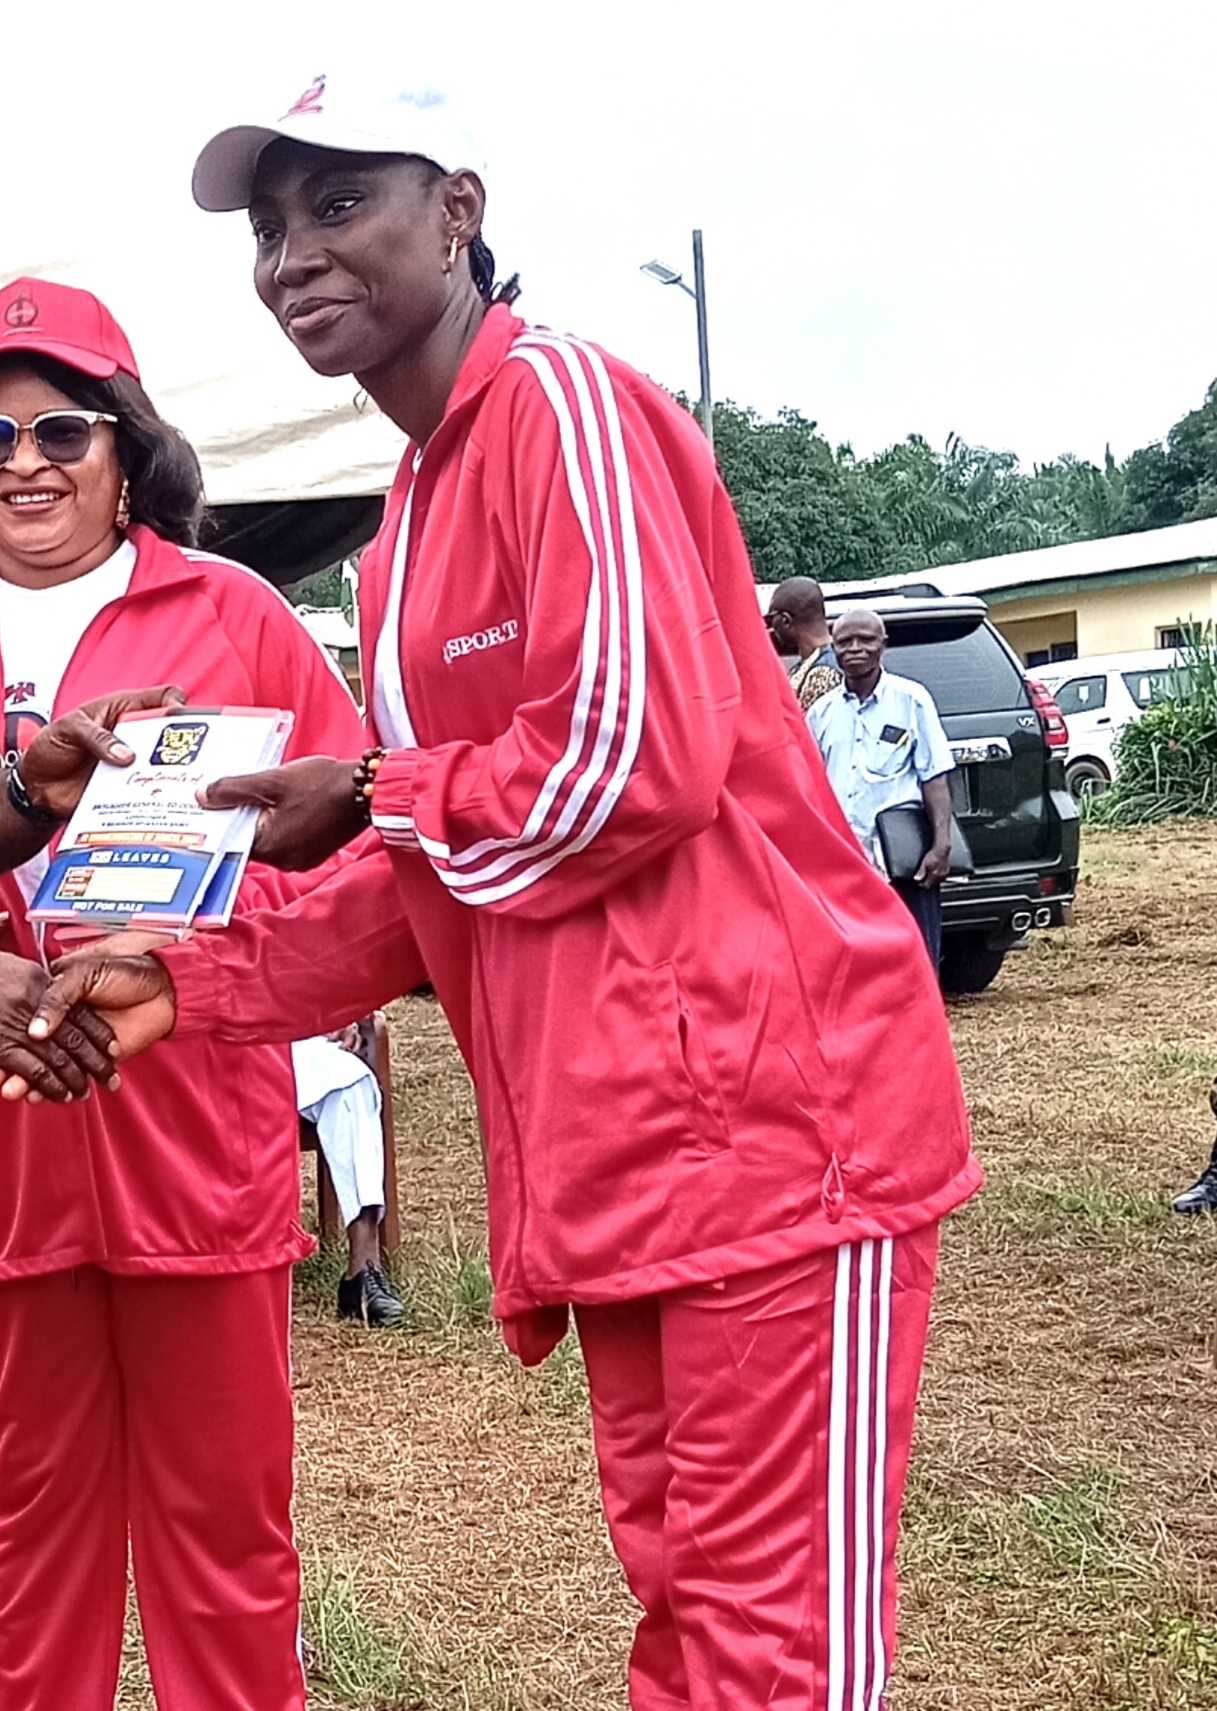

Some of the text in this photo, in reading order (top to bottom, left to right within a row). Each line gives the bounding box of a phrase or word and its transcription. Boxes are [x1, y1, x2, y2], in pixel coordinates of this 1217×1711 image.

[1017, 716, 1035, 728] VX
[112, 851, 170, 865] LEAVES
[71, 901, 95, 912] NOT
[95, 901, 117, 912] FOR
